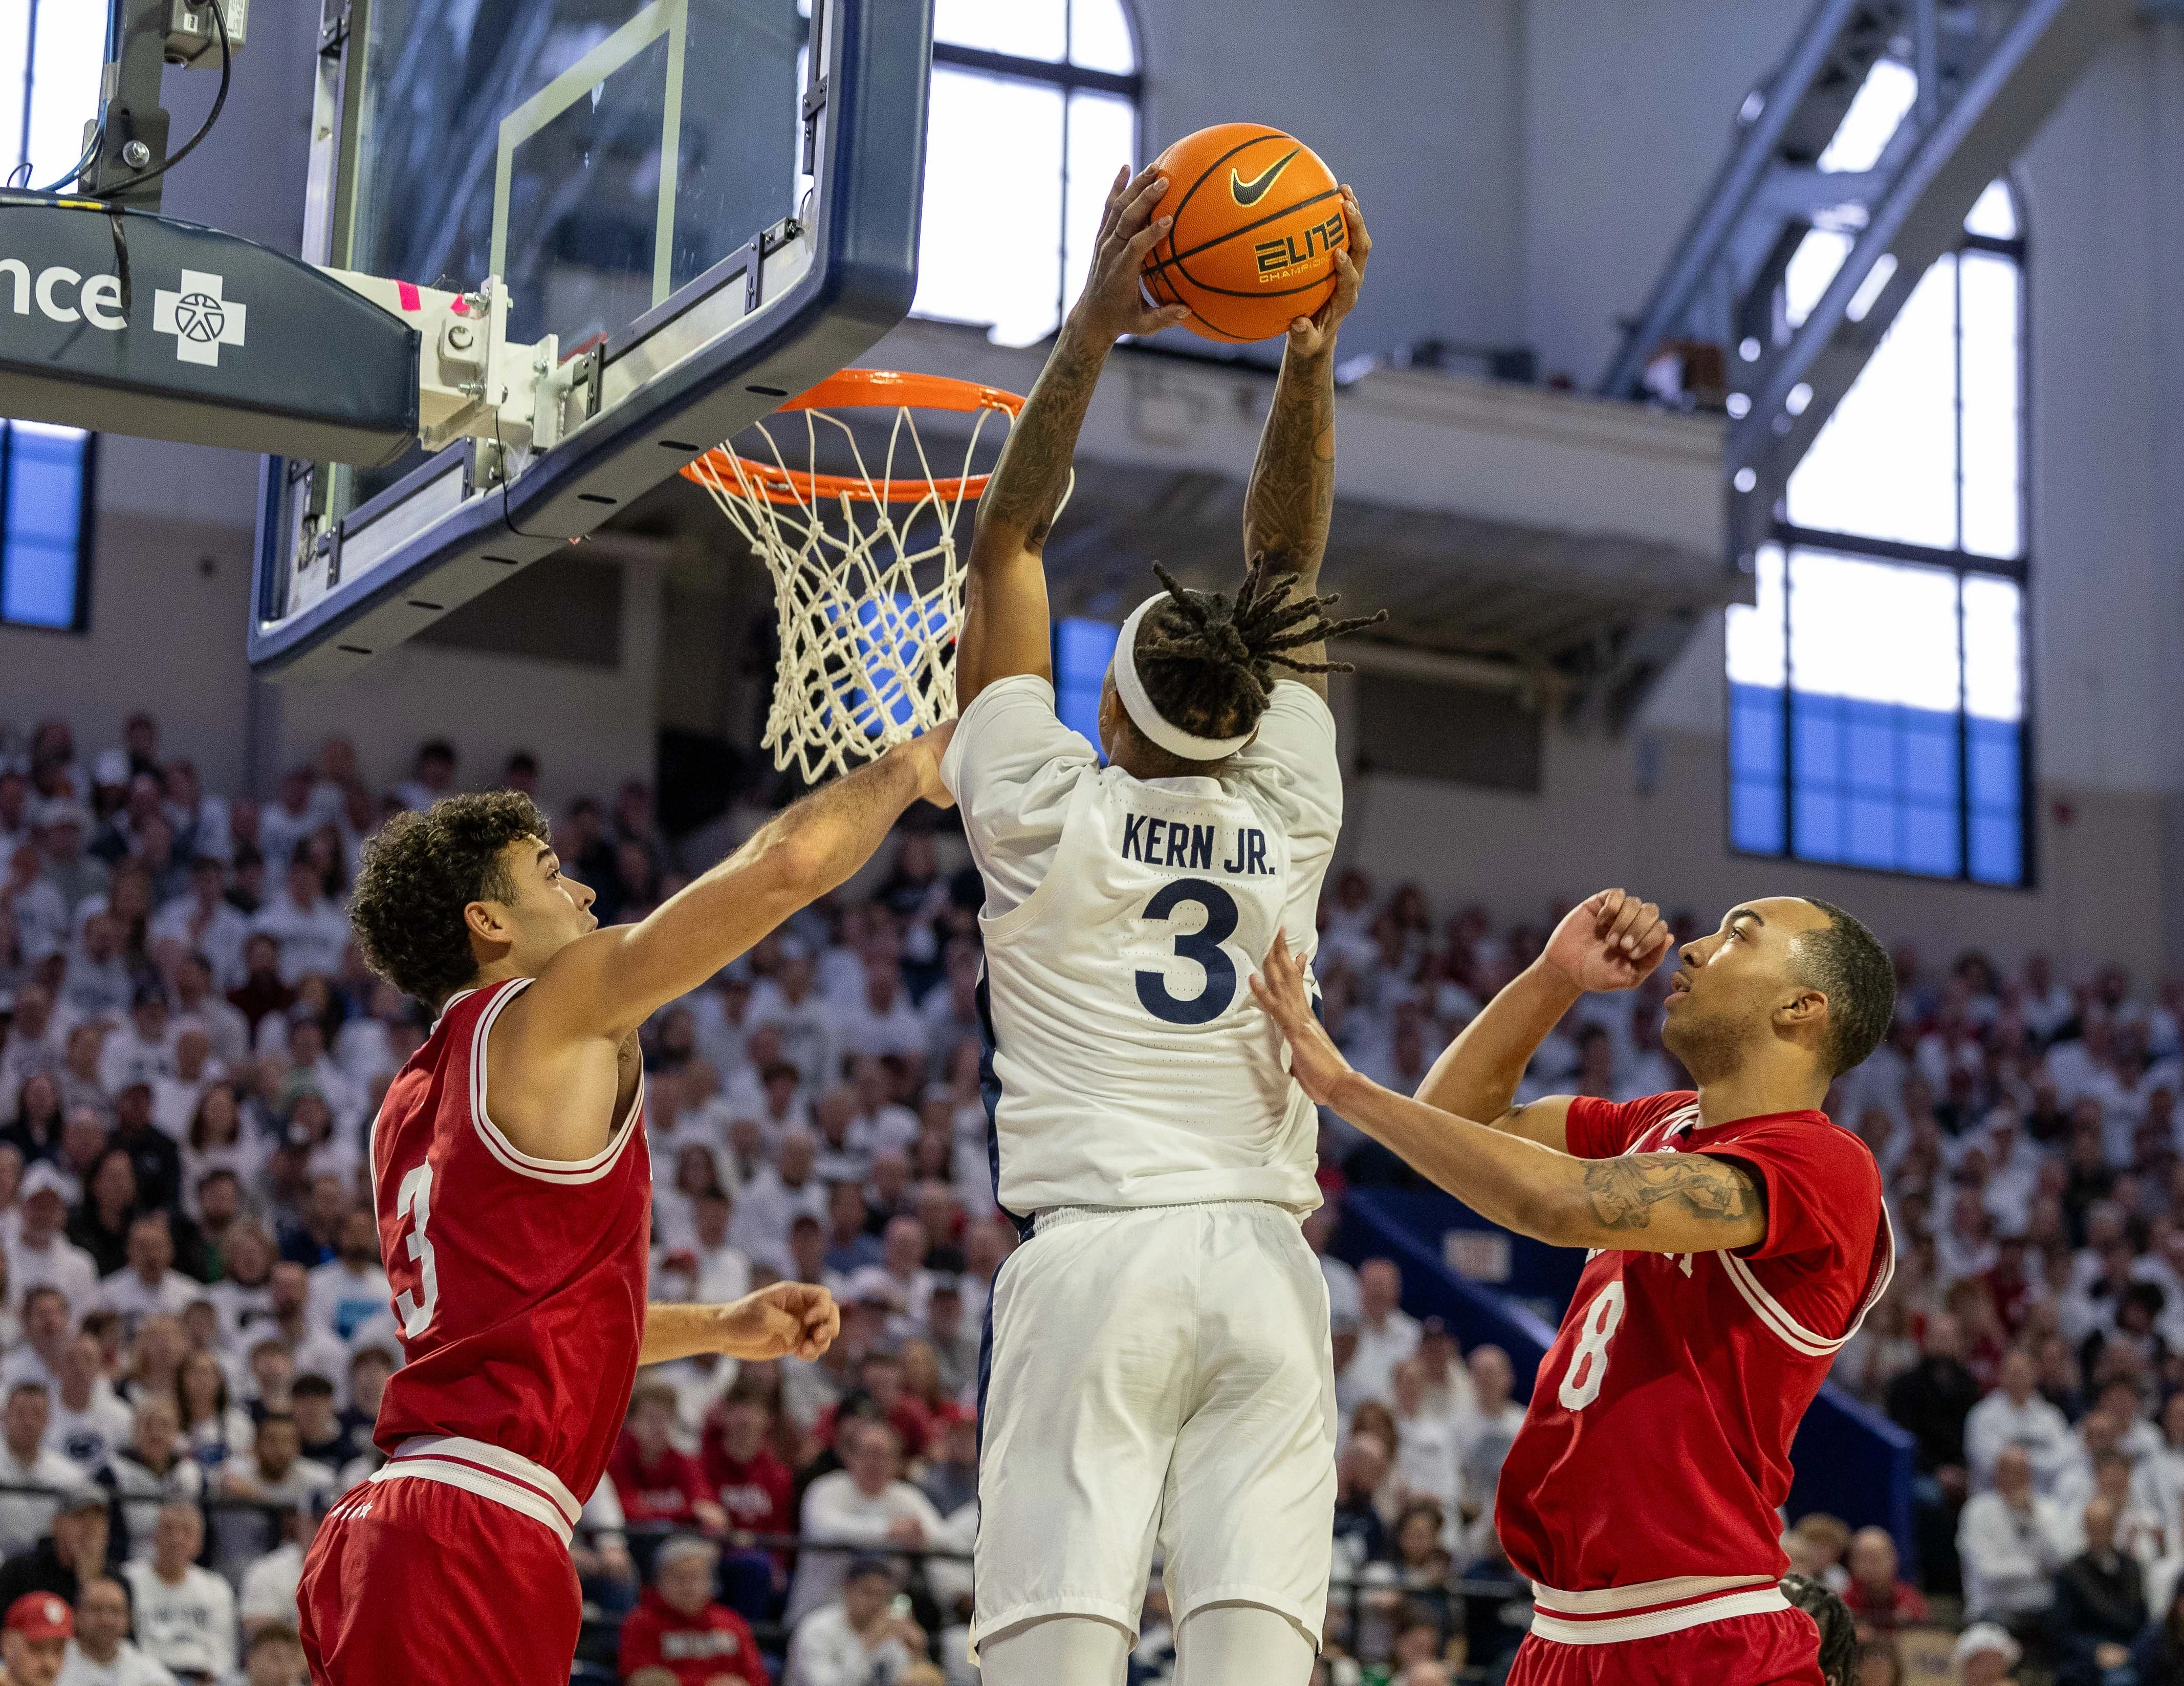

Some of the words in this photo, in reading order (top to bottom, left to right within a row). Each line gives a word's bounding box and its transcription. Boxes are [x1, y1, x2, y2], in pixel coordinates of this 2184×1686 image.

[1254, 212, 1345, 274] ELITE
[1122, 813, 1215, 870] KERN
[1224, 828, 1276, 875] JR.
[1135, 878, 1239, 1025] 3
[396, 1155, 439, 1339] 3
[1559, 1281, 1625, 1411] 8
